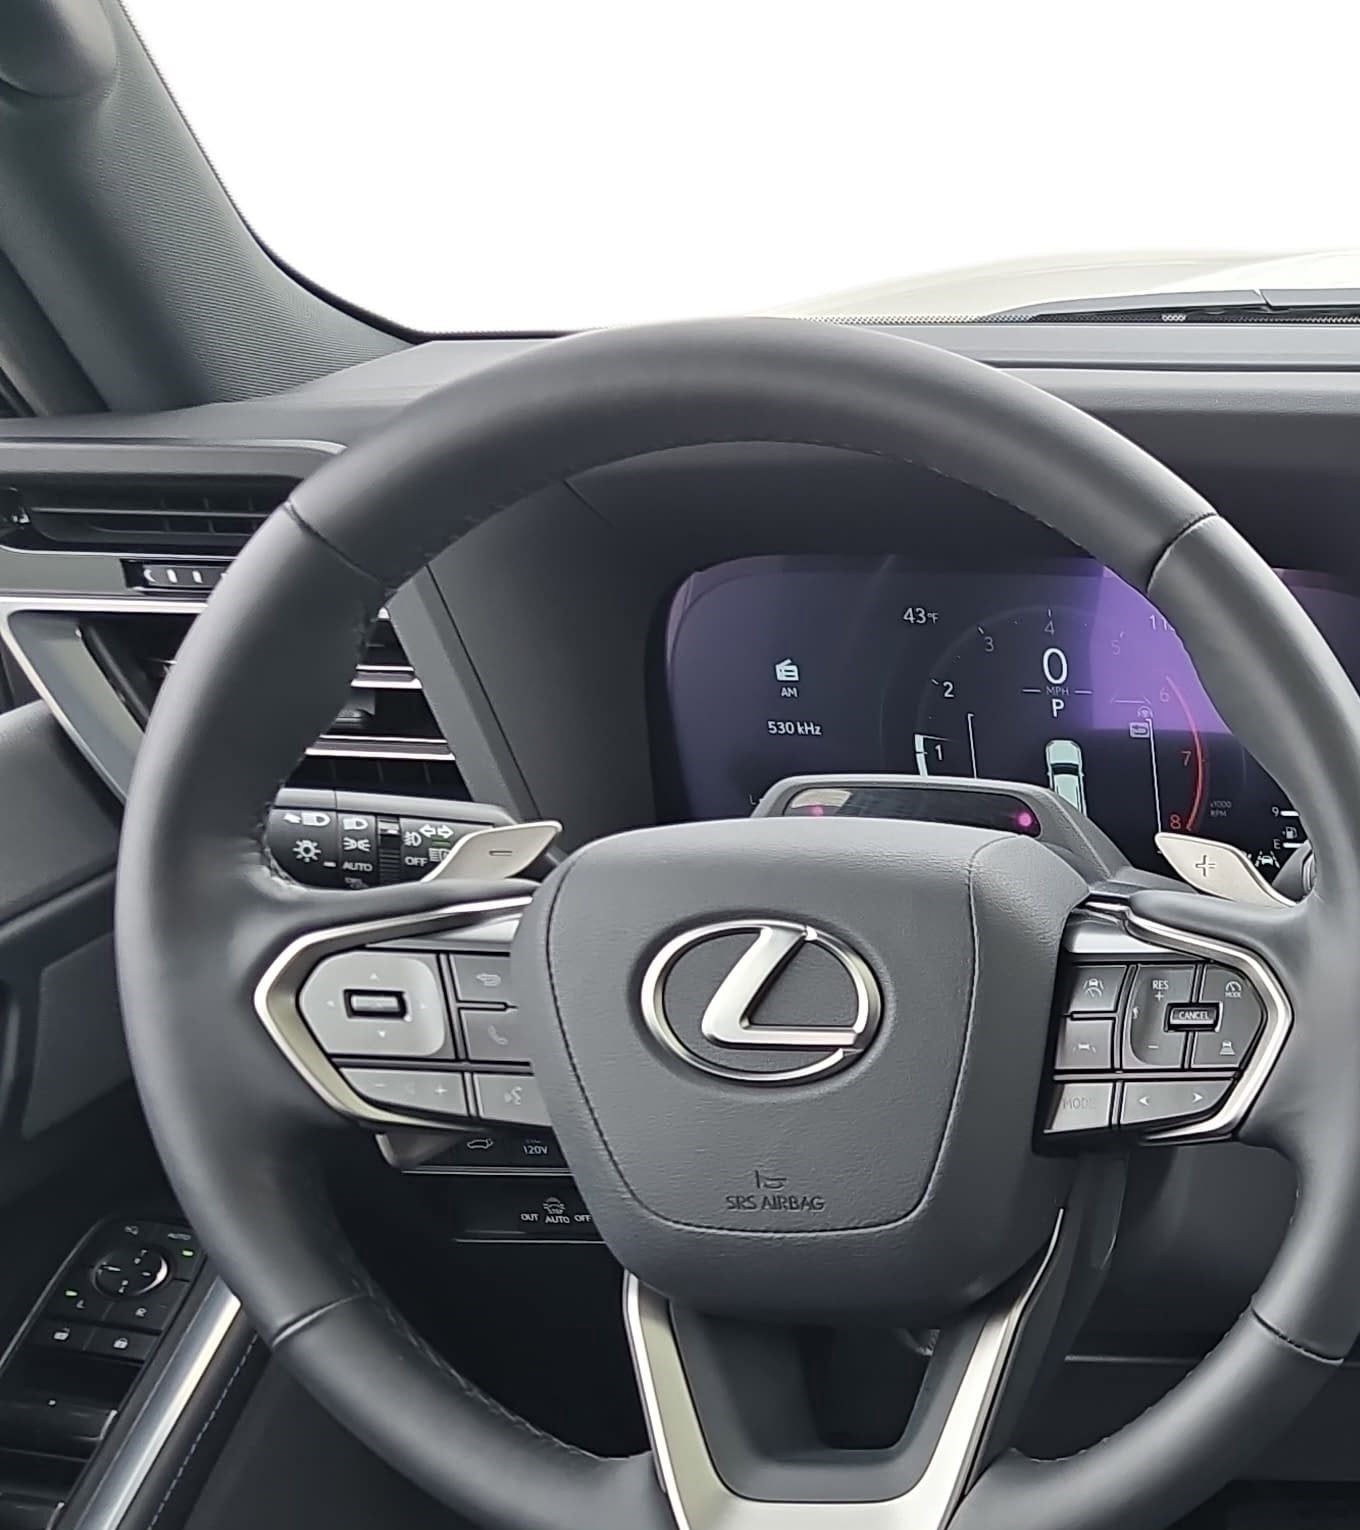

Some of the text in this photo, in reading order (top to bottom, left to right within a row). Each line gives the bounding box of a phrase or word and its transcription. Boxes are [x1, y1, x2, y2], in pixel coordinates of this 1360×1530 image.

[1044, 620, 1055, 635] 4
[983, 636, 995, 652] 3
[781, 687, 799, 698] AM
[943, 681, 955, 698] 2
[1045, 686, 1070, 696] MPH
[1160, 689, 1170, 703] 6
[1051, 698, 1065, 718] P
[767, 720, 822, 736] 530 kHz
[934, 743, 943, 761] 1
[1182, 751, 1192, 767] 7
[1169, 814, 1182, 831] 8
[1273, 838, 1281, 850] E
[342, 861, 373, 872] AUTO
[404, 856, 428, 867] OFF
[1152, 980, 1169, 990] RES
[1178, 1010, 1210, 1021] CANCEL
[523, 1145, 548, 1155] 120V
[725, 1194, 825, 1211] SRS AIRBAG
[520, 1213, 592, 1224] OUT AUTO OFF
